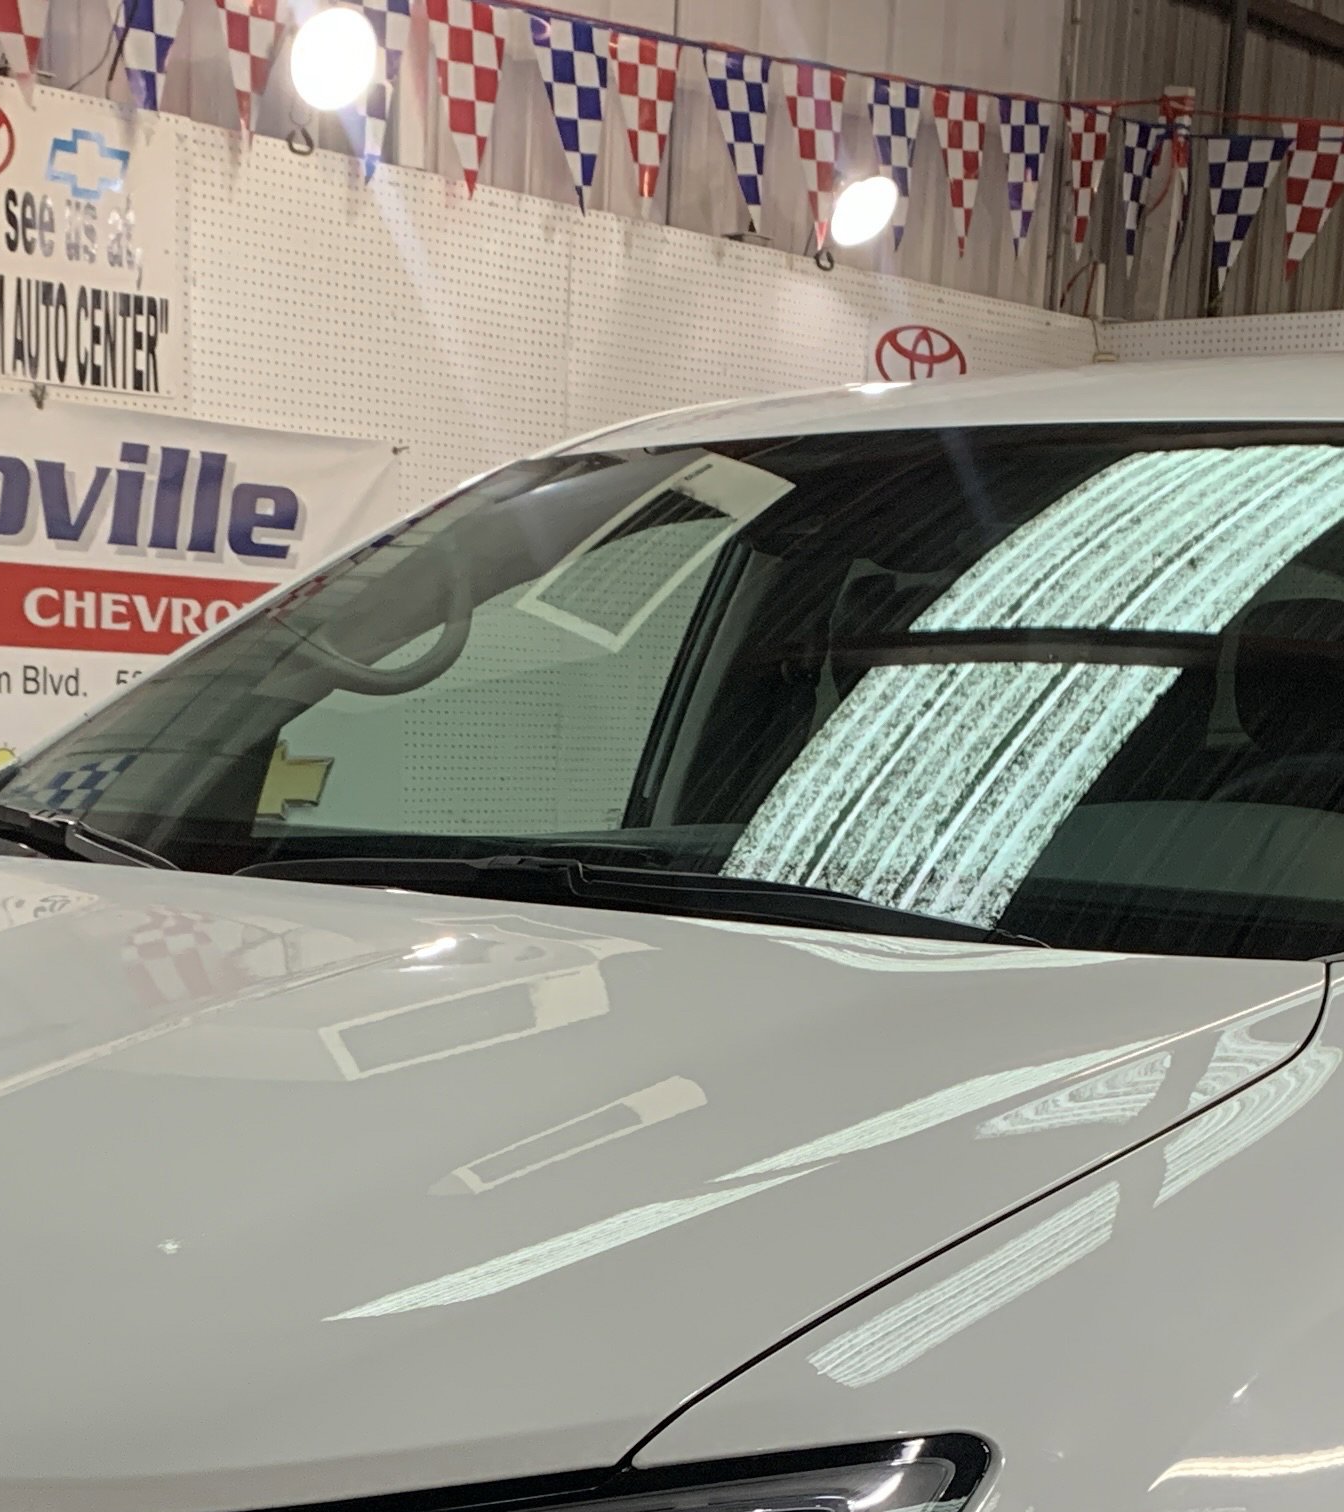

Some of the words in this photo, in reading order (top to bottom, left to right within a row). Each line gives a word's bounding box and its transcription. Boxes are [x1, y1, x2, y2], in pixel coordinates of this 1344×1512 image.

[5, 188, 56, 257] see
[64, 199, 98, 264] us
[12, 277, 68, 383] AUTO
[23, 587, 253, 636] CHEVRO
[22, 665, 87, 697] Blvd.
